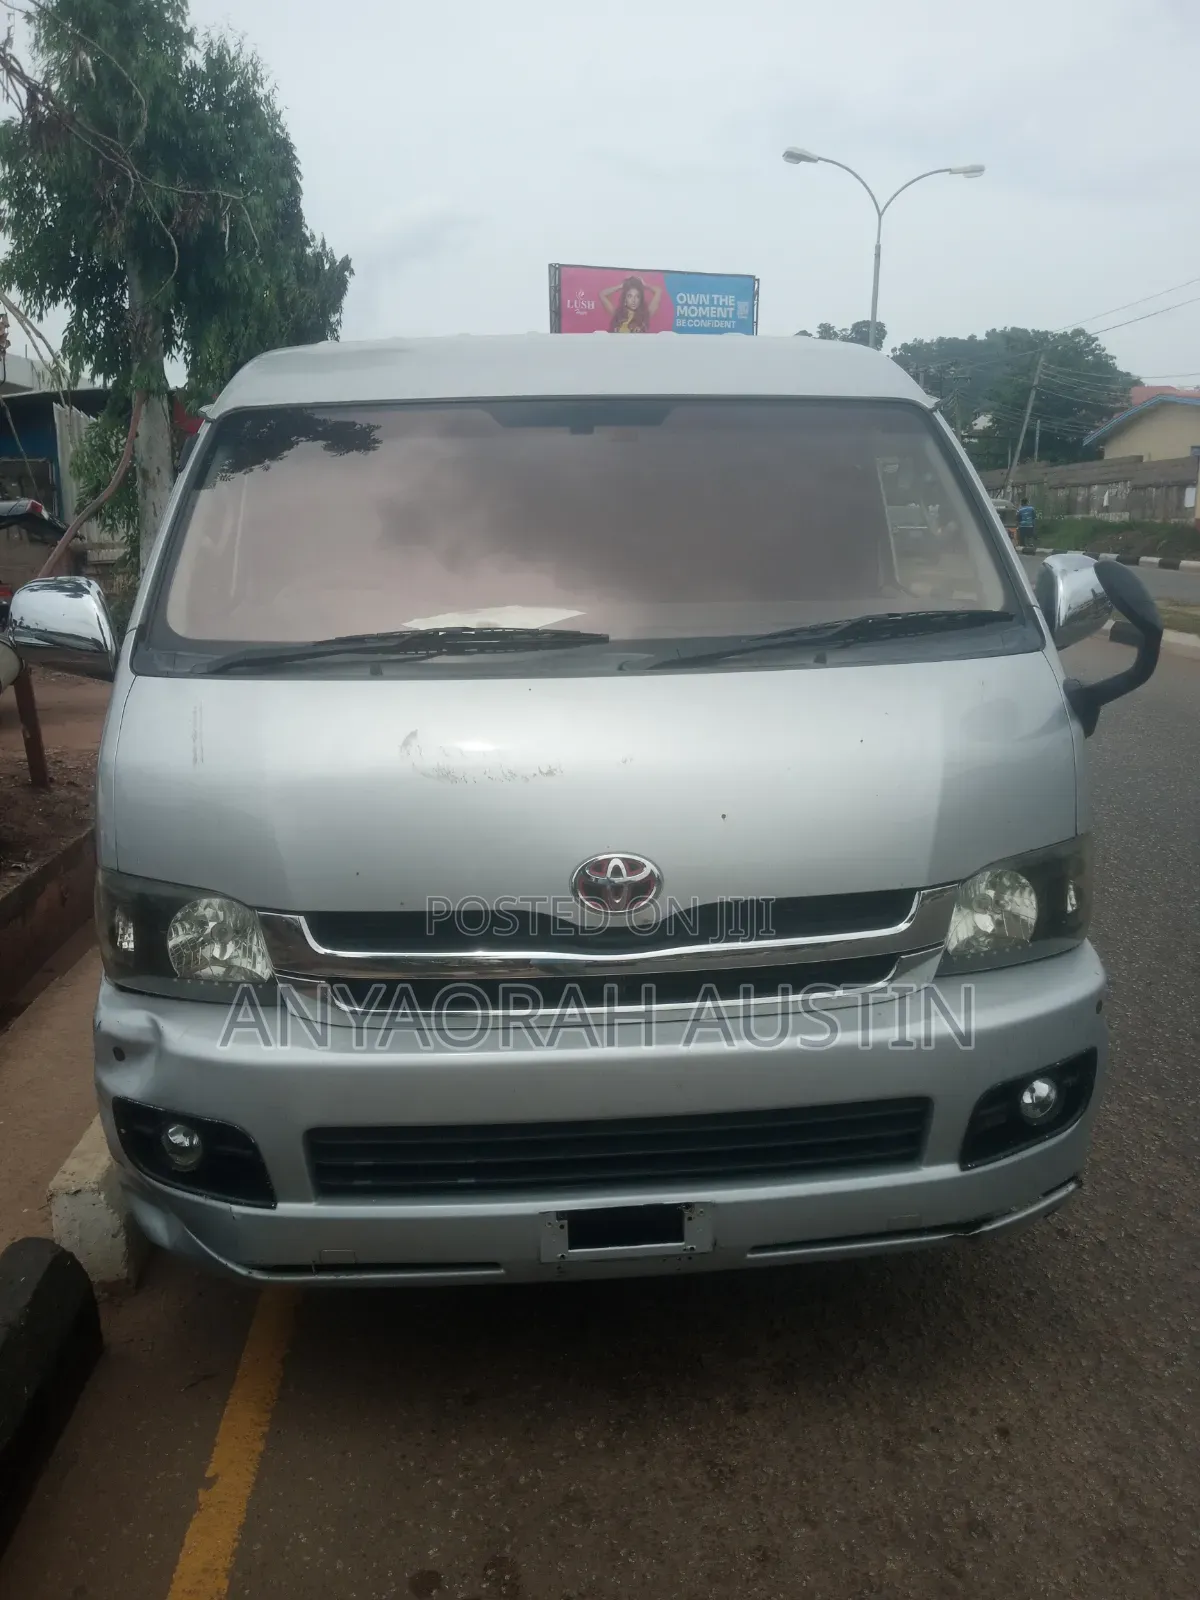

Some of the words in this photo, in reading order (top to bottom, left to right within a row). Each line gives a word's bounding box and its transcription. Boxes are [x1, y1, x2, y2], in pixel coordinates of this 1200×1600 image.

[566, 299, 595, 310] LUSH
[676, 292, 709, 305] OWN
[712, 294, 735, 306] THE
[676, 305, 735, 318] MOMENT
[676, 318, 686, 327] BE
[687, 319, 736, 328] CONFIDENT
